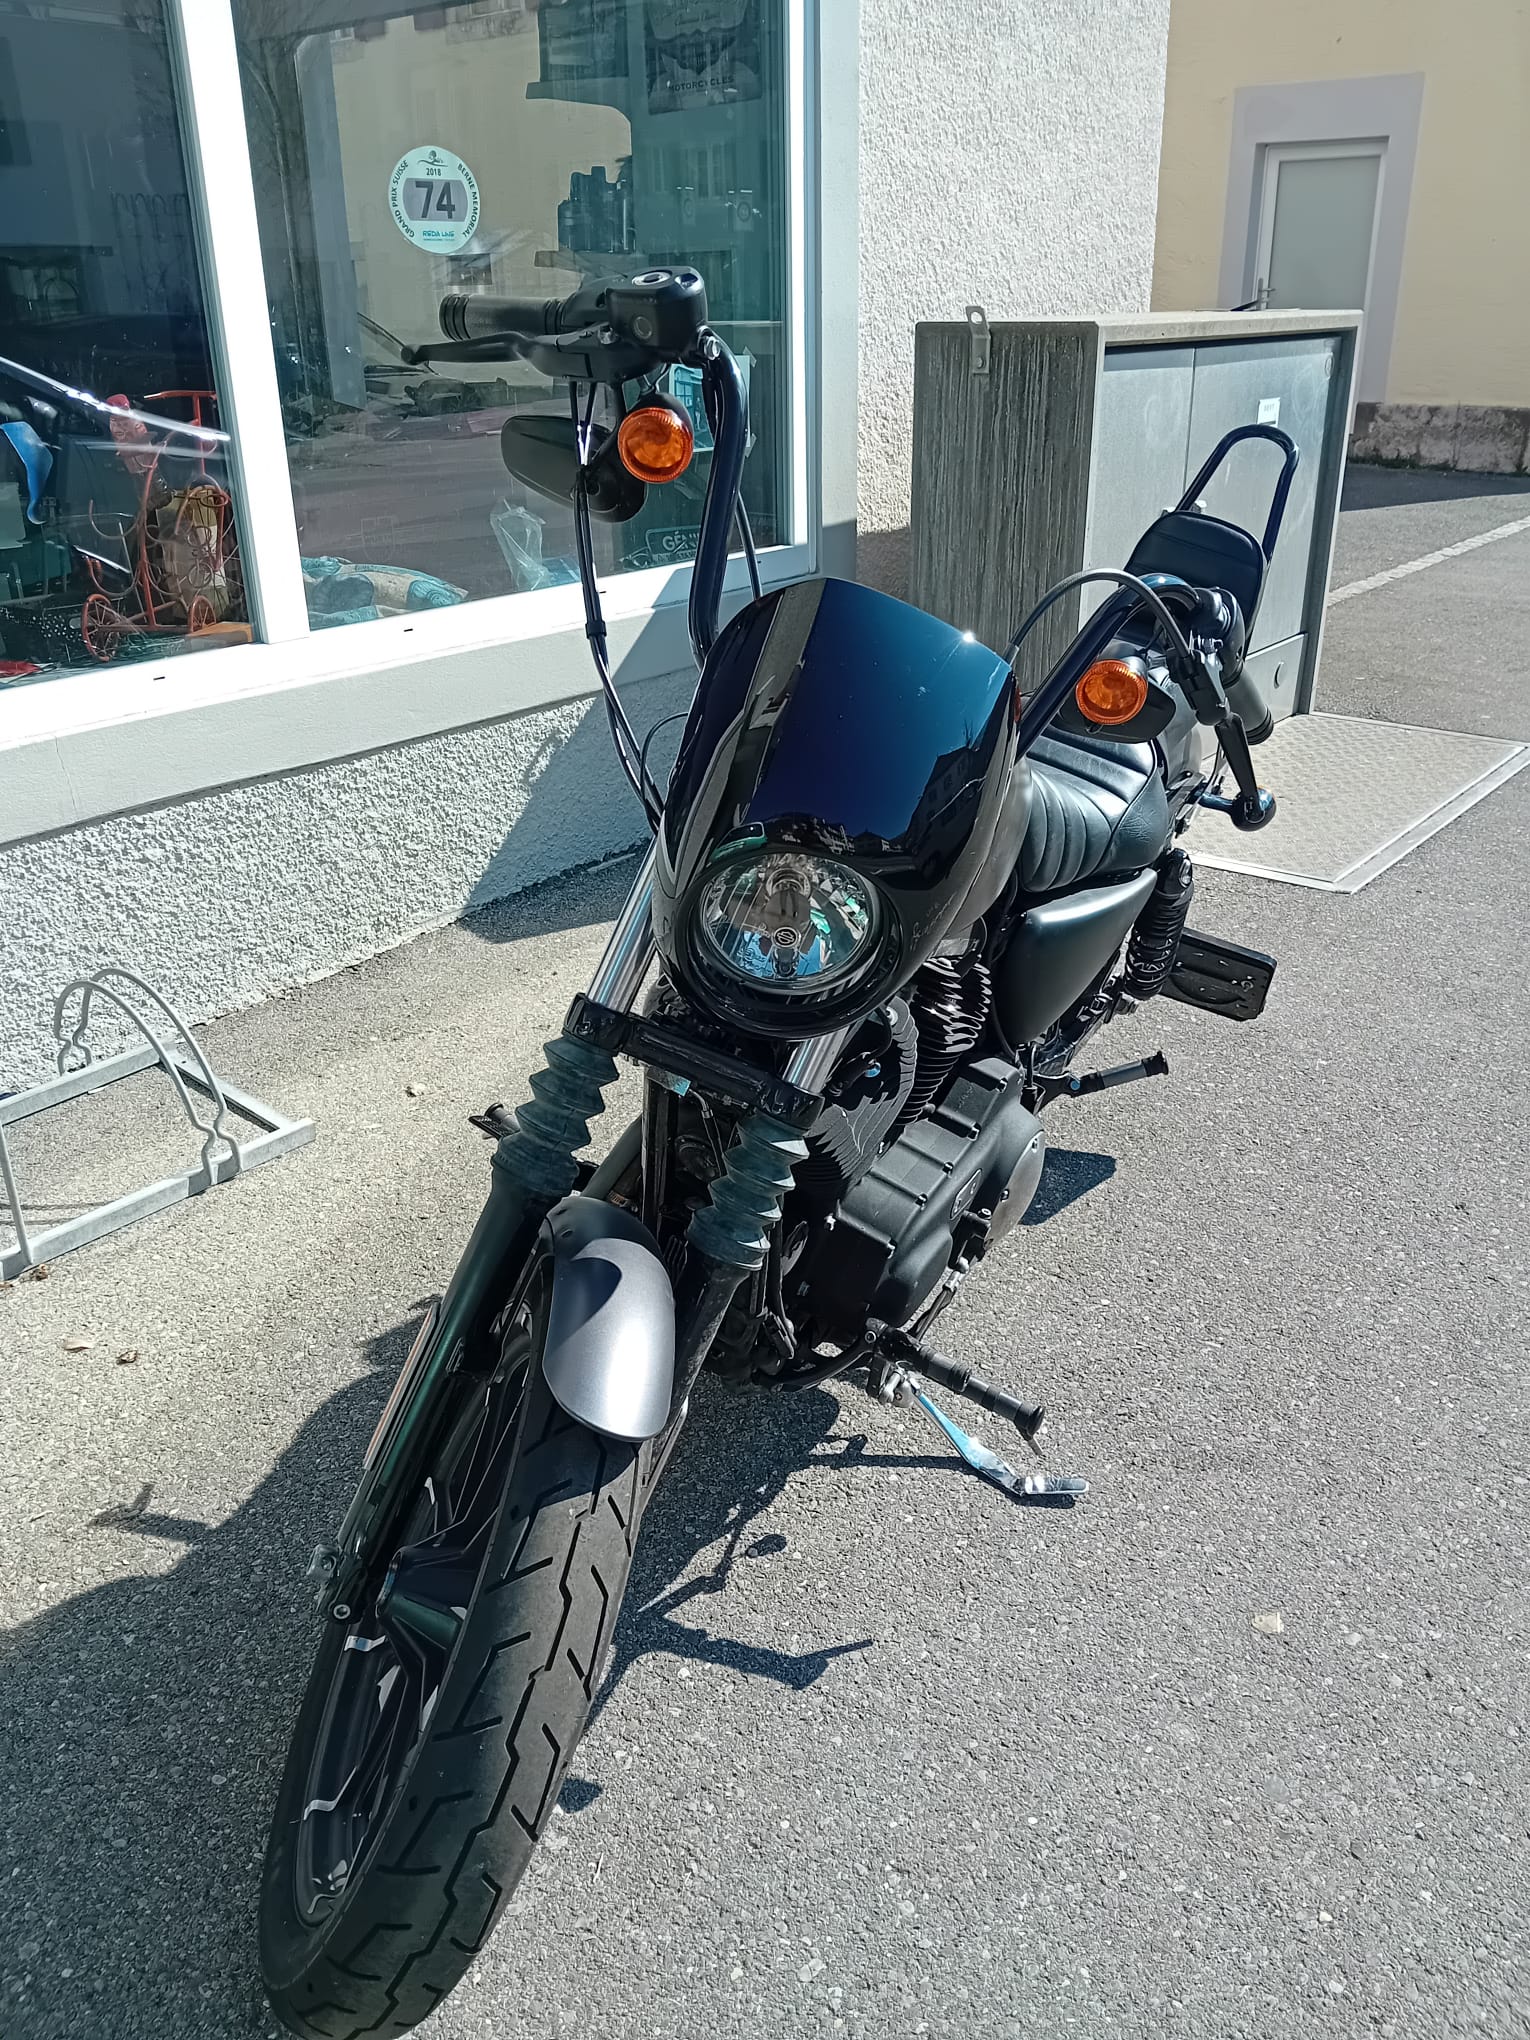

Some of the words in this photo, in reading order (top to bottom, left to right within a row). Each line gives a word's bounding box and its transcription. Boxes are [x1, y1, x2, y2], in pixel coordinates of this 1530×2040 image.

[392, 160, 409, 185] SUISSE
[425, 167, 442, 176] 2018
[457, 163, 475, 190] BERNE
[415, 180, 456, 219] 74
[394, 209, 415, 238] GRAND
[461, 191, 478, 237] MEMORIAL
